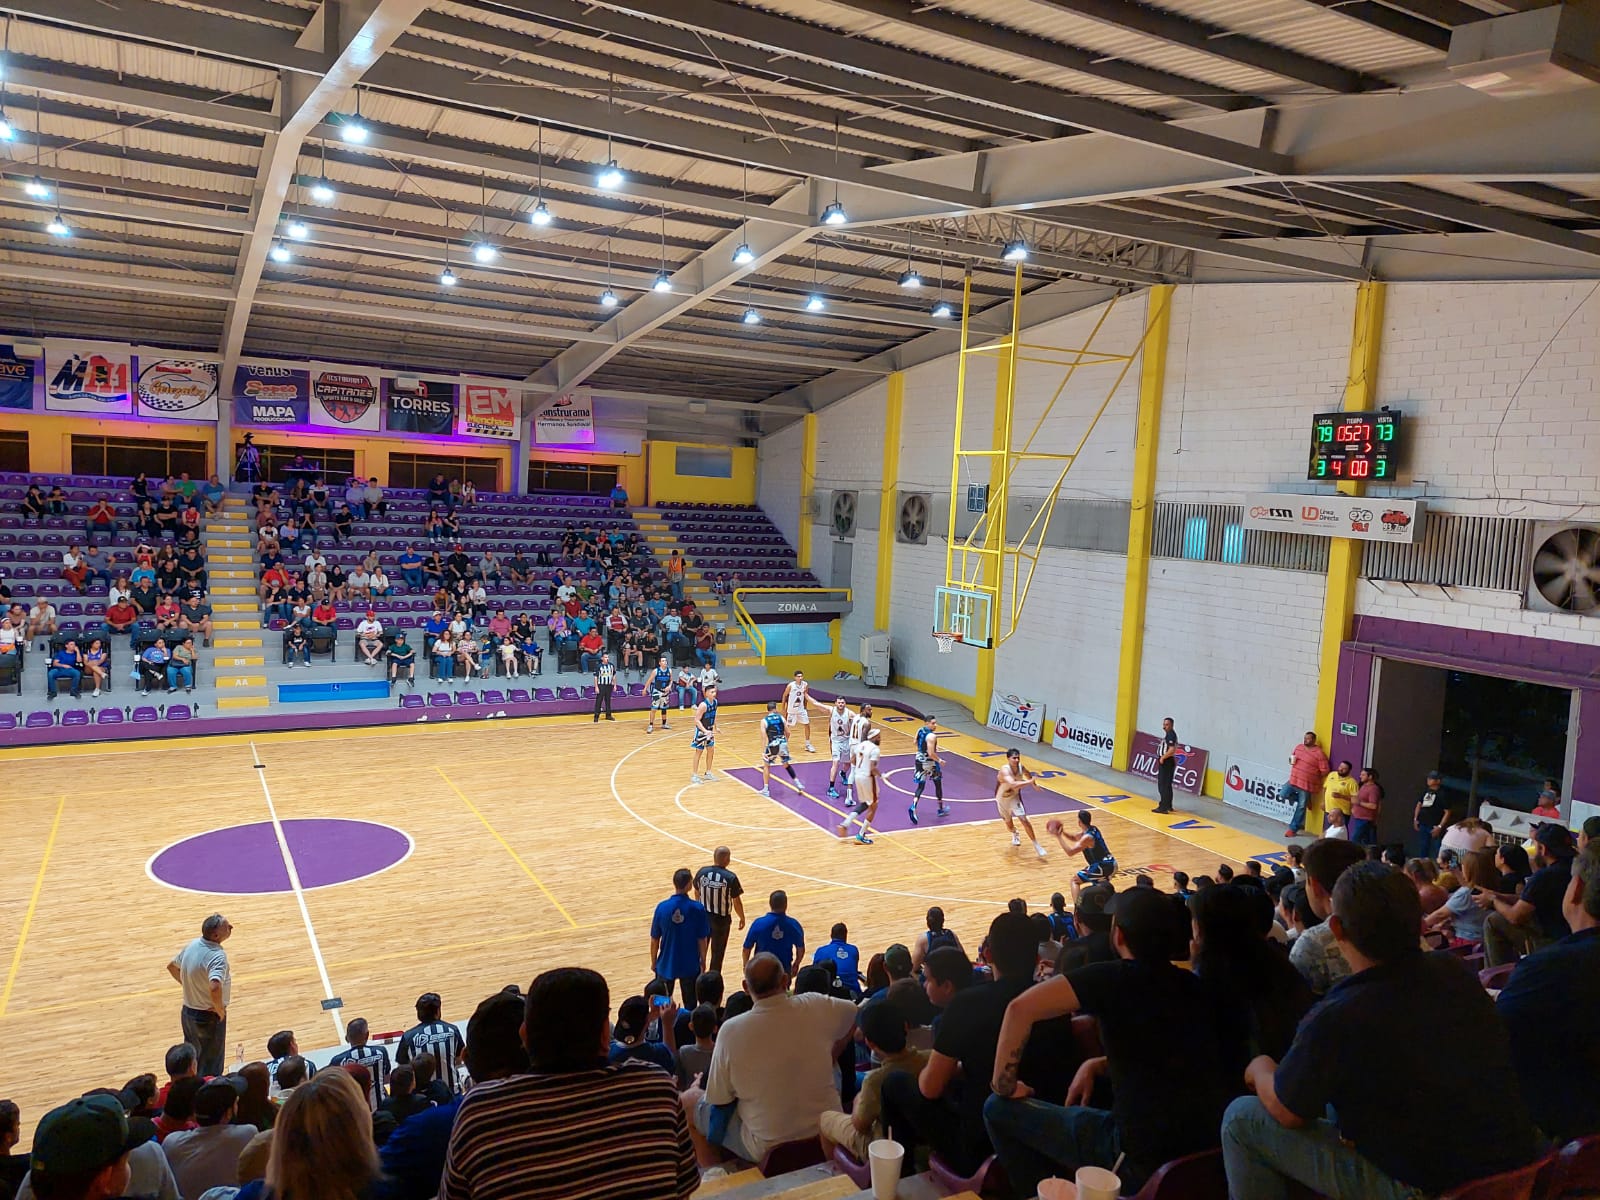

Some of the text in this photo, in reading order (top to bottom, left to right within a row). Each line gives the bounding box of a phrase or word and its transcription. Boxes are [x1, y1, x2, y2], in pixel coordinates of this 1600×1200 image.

[317, 385, 373, 398] CAPITANES
[391, 397, 451, 413] TORRES
[469, 389, 515, 414] EM
[253, 406, 295, 417] MAPA
[539, 408, 590, 417] onstrurama
[467, 414, 513, 426] Menchaca
[1317, 426, 1333, 442] 79
[1376, 424, 1394, 441] 73
[1317, 461, 1386, 476] 3 4 00 3
[991, 711, 1038, 736] IMUDEG
[1056, 717, 1114, 750] Guasave
[1132, 753, 1198, 787] IMUEG
